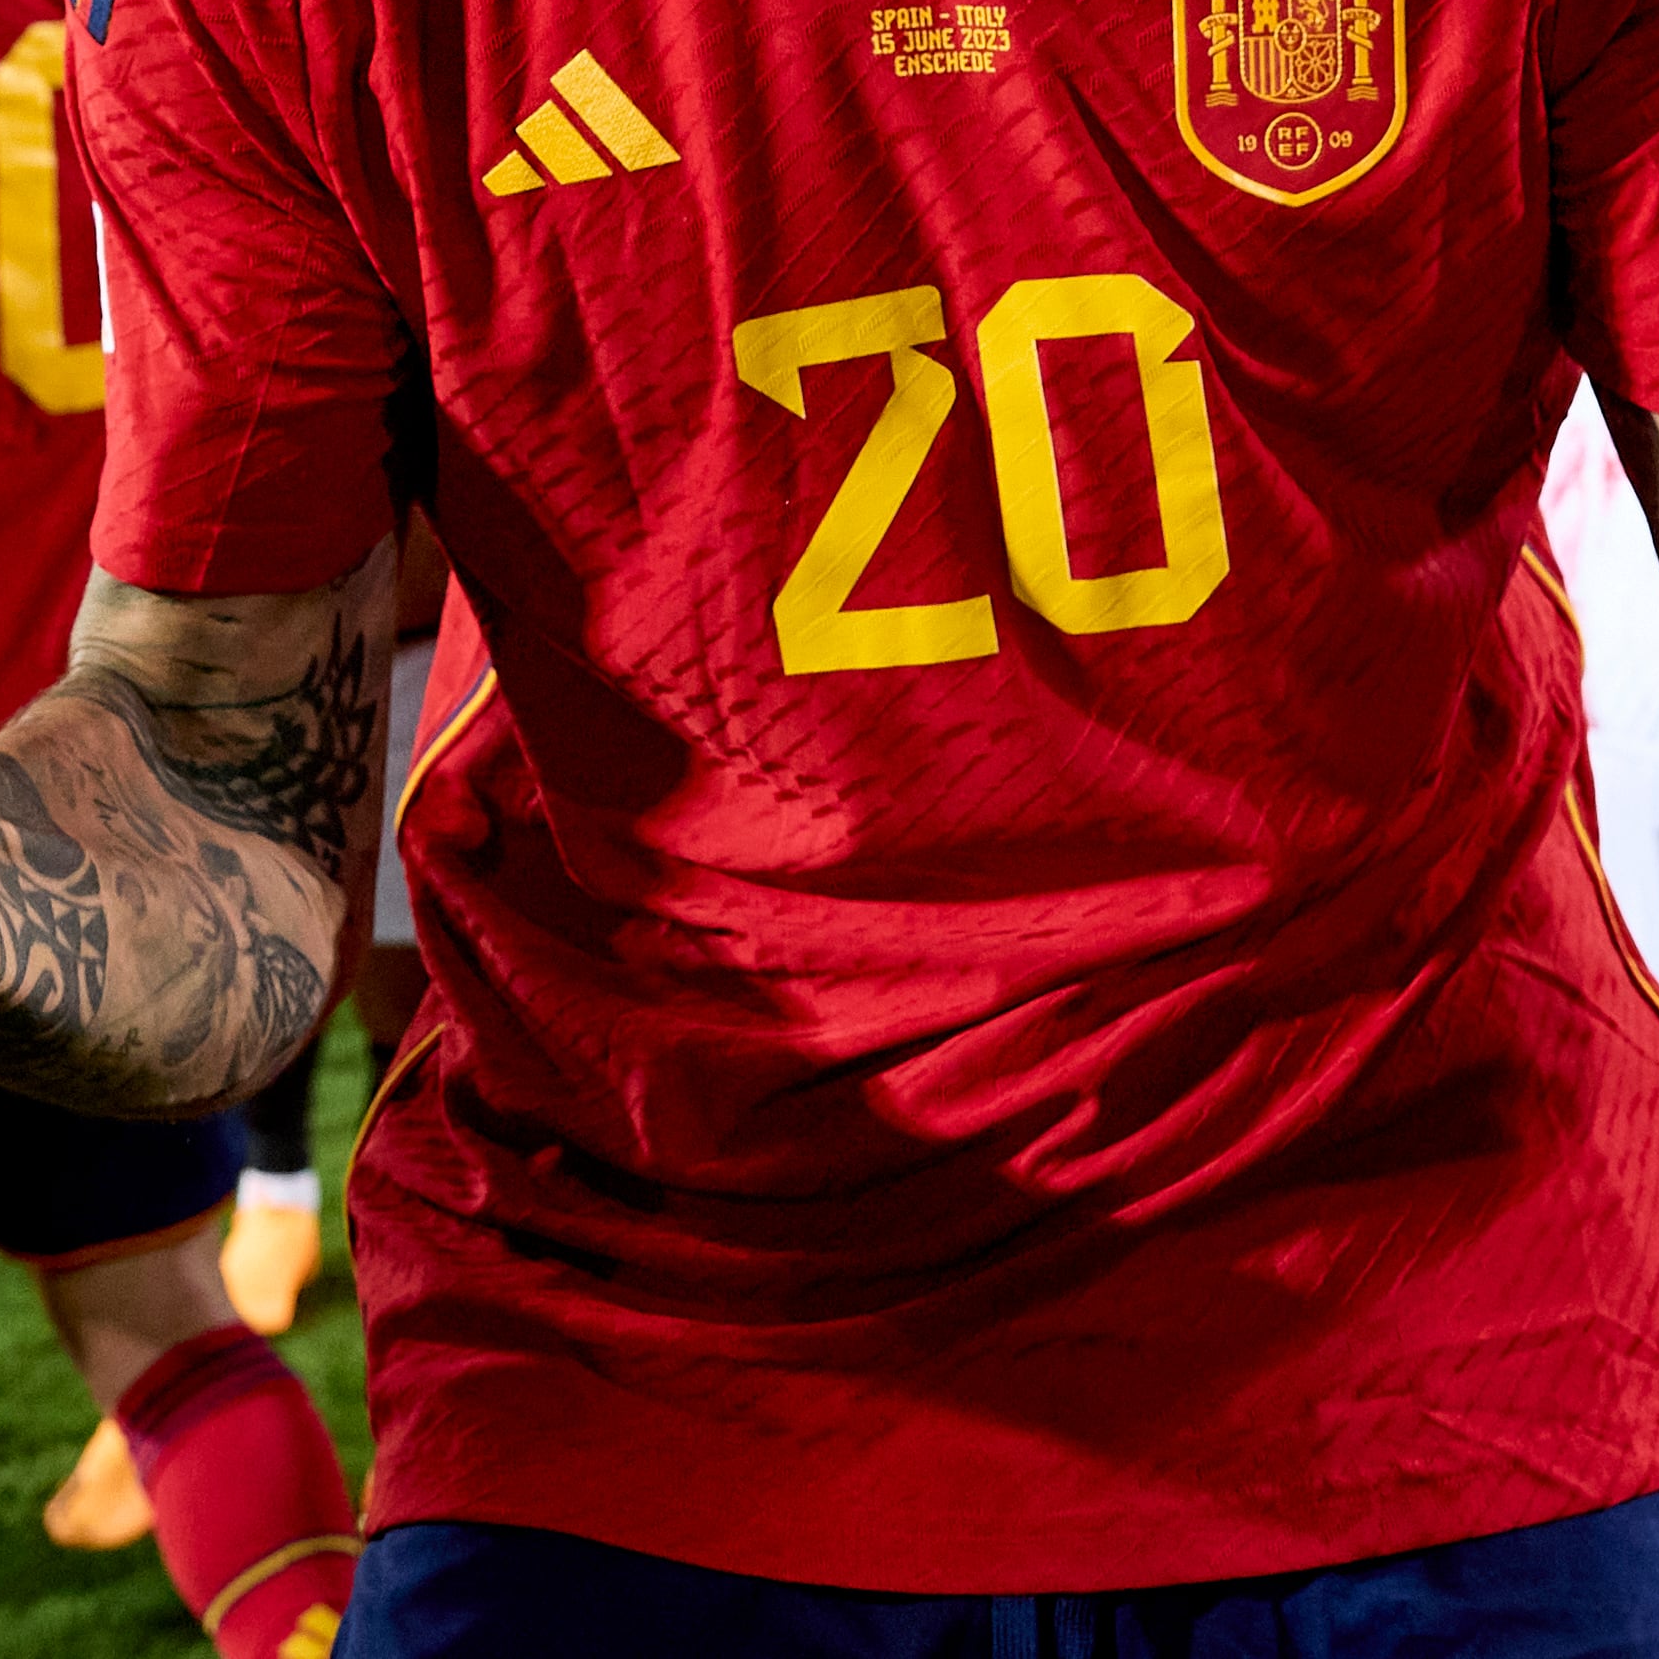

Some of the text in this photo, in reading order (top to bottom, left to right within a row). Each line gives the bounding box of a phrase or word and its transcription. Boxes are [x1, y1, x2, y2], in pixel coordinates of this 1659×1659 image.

[871, 6, 933, 31] SPAIN
[955, 5, 1007, 28] ITALY
[871, 28, 1011, 55] 15 JUNE 2023
[894, 51, 996, 77] ENSCHEDE
[1238, 134, 1258, 152] 19
[1329, 129, 1353, 148] 09
[733, 273, 1231, 676] 20
